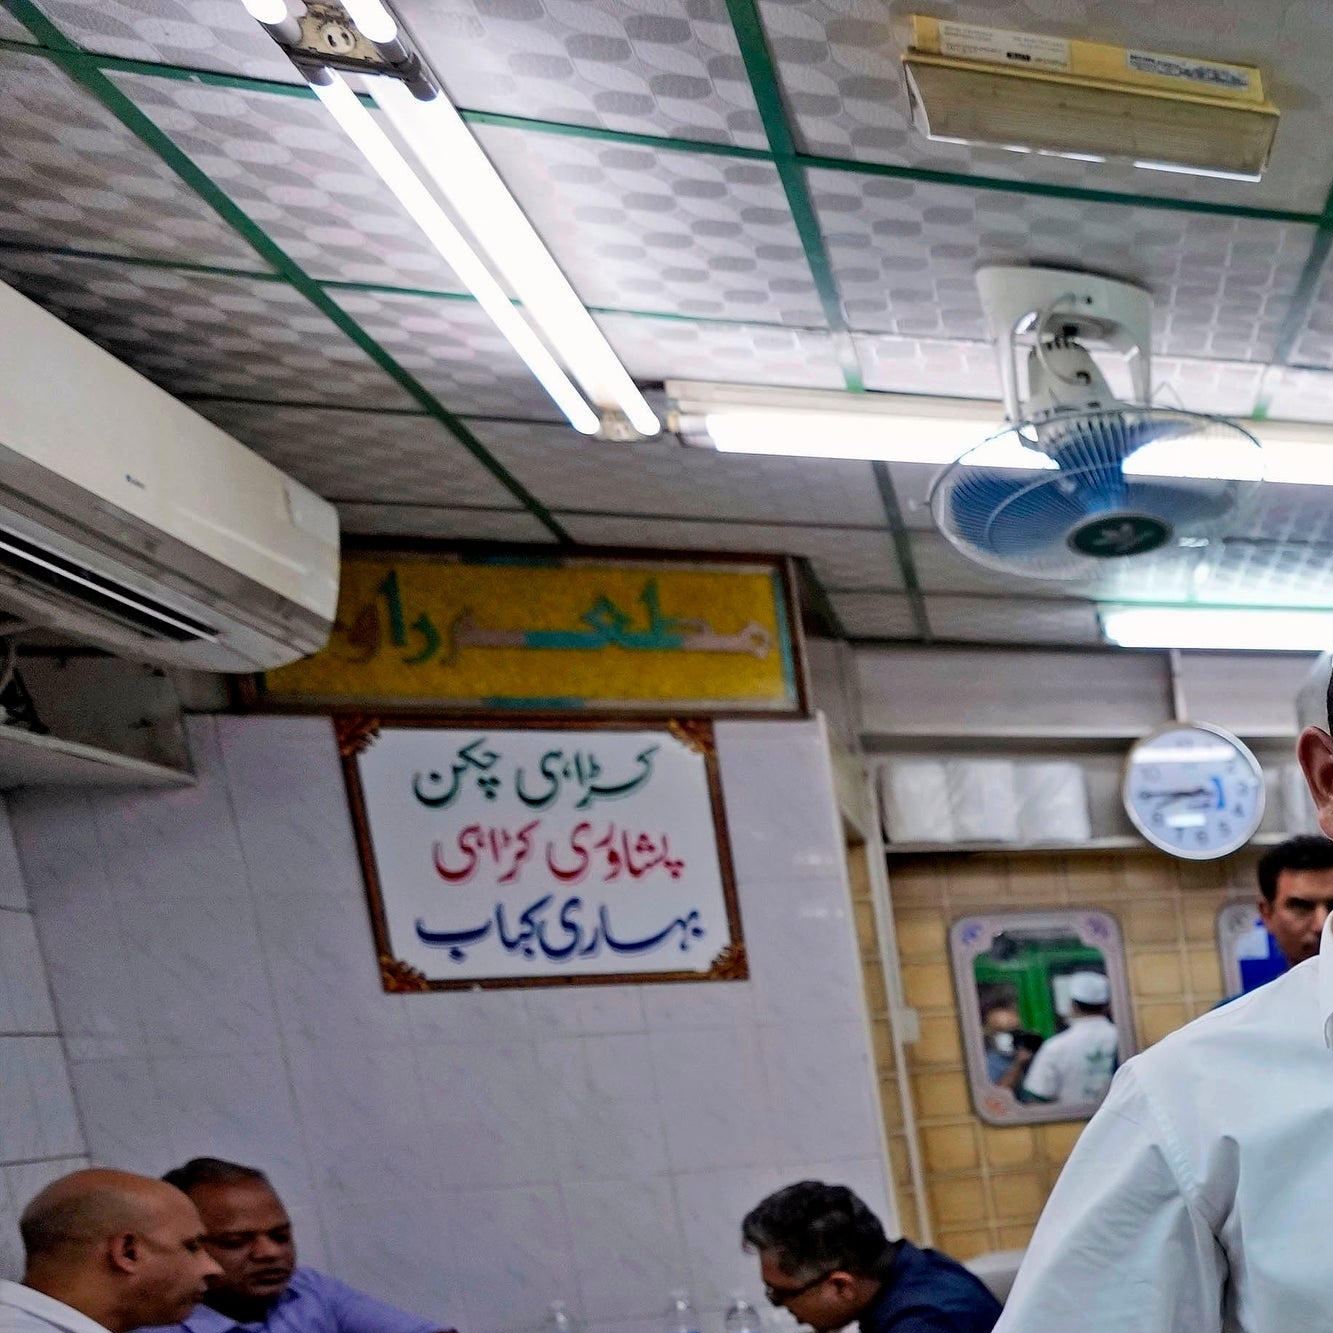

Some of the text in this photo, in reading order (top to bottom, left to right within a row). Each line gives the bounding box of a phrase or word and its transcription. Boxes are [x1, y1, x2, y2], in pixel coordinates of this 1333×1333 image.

[334, 569, 441, 667] راو
[413, 737, 501, 807] چکن
[415, 894, 554, 962] کباب
